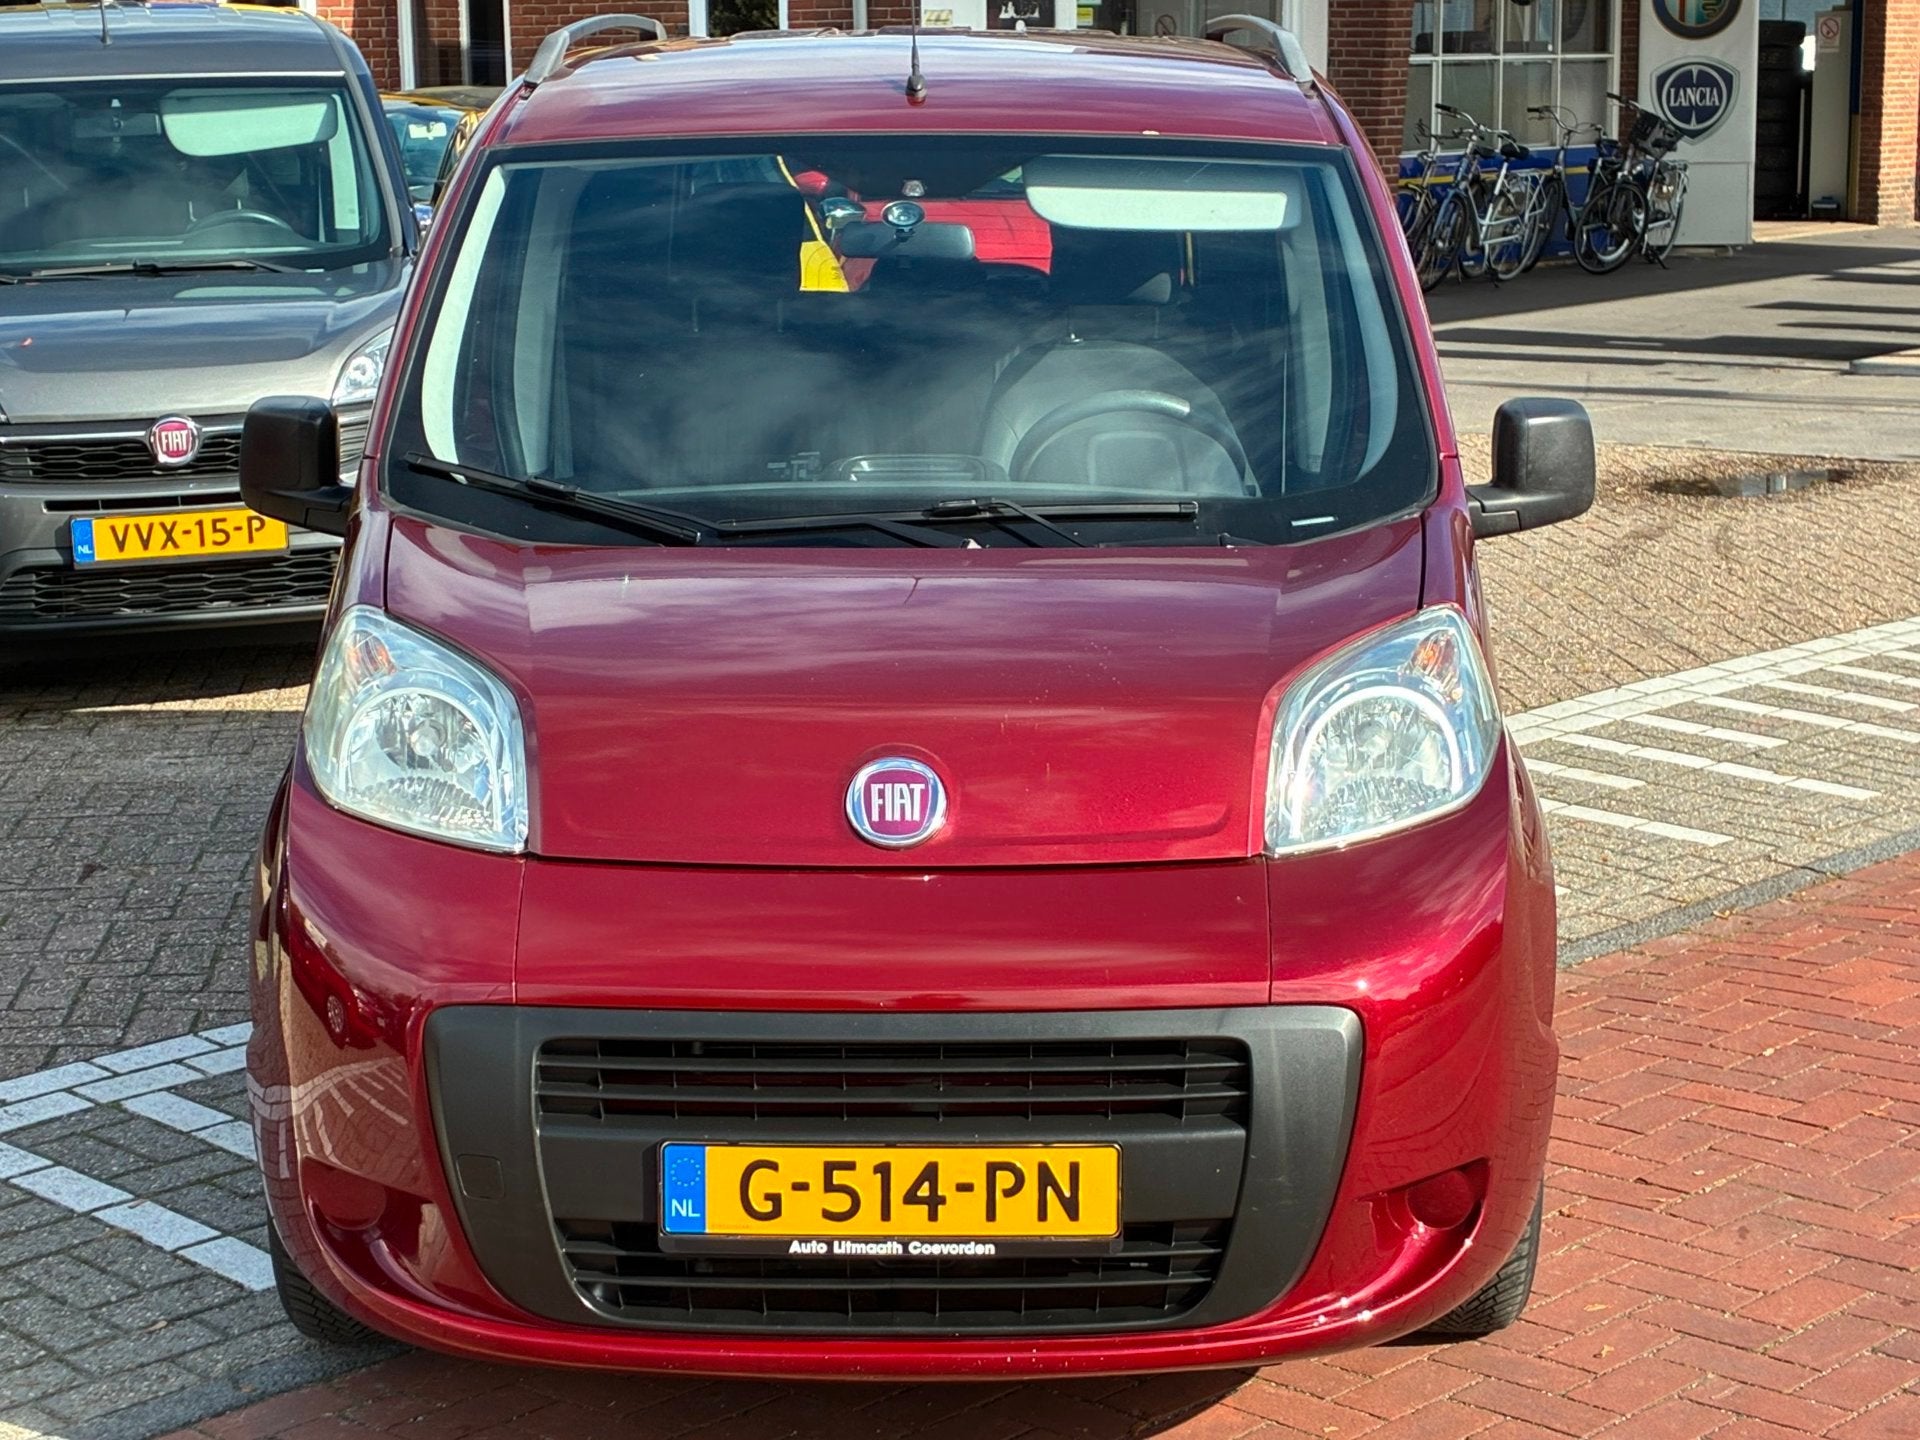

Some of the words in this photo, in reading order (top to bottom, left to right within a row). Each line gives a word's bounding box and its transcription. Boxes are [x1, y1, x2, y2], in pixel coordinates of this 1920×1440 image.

[1669, 87, 1720, 107] LANCIA
[161, 429, 188, 452] FIAT
[109, 515, 266, 553] VVX-15-P
[77, 544, 93, 554] NL
[870, 783, 925, 822] FIAT
[739, 1158, 1080, 1223] G-514-PN
[671, 1198, 701, 1218] NL
[789, 1239, 828, 1255] Auto
[833, 1240, 903, 1255] Litmaath
[908, 1241, 996, 1255] Coevorden
